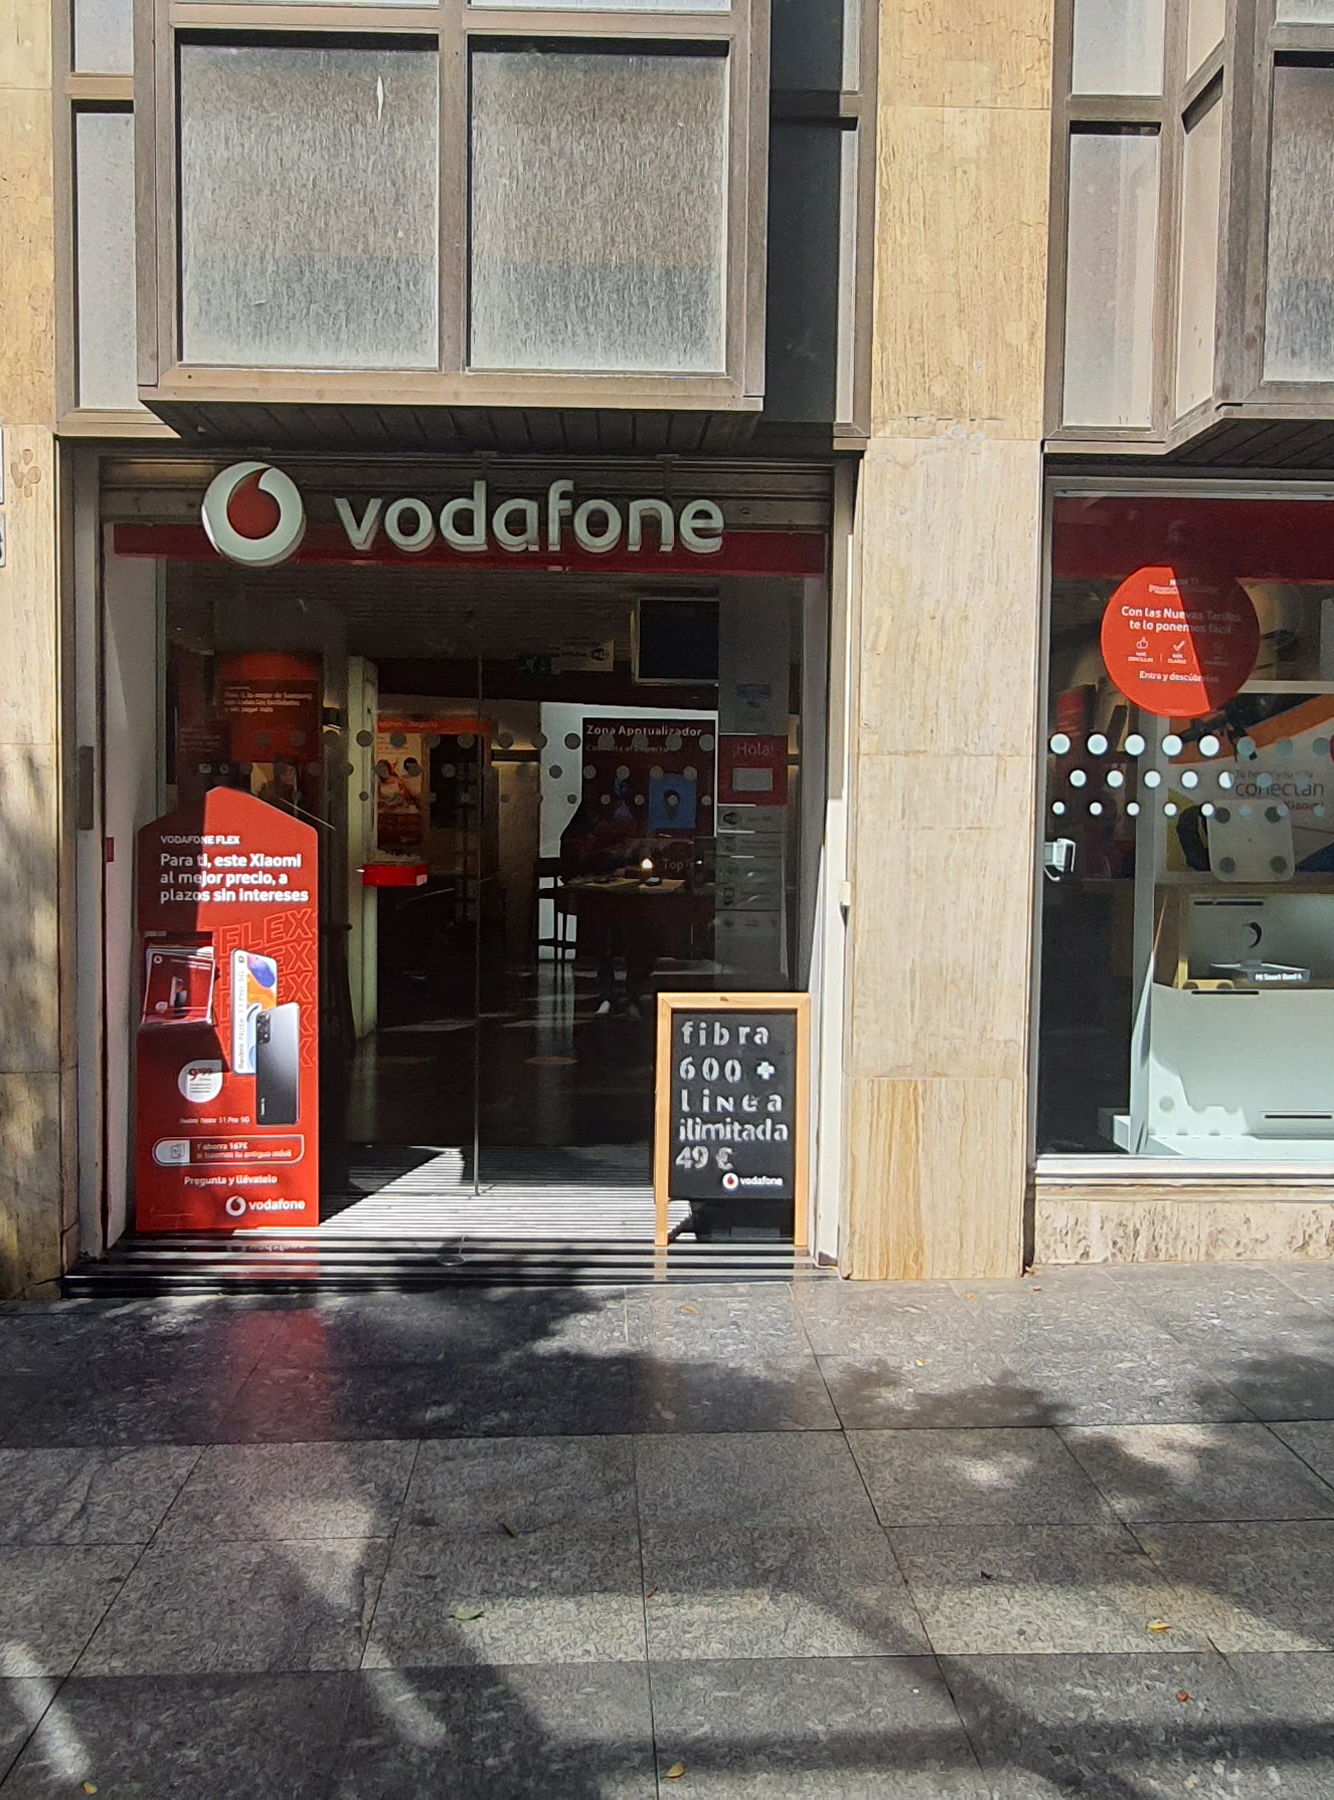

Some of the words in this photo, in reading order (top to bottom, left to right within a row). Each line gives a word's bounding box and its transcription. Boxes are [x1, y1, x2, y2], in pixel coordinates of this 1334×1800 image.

[334, 479, 725, 554] vodafone
[1121, 606, 1143, 616] Con
[1144, 607, 1161, 618] las
[1163, 608, 1204, 620] Nuevas
[1207, 611, 1241, 622] Tarifas
[1129, 620, 1141, 629] te
[1143, 620, 1154, 630] lo
[1156, 622, 1206, 633] ponemos
[1139, 671, 1162, 680] Entra
[1163, 673, 1168, 682] y
[586, 725, 616, 735] Zona
[160, 835, 214, 845] VODAFONE
[216, 835, 240, 845] FLEX
[160, 854, 193, 867] Para
[197, 854, 212, 869] ti,
[214, 854, 247, 867] este
[249, 853, 301, 867] Xiaomi
[160, 871, 174, 884] al
[178, 871, 223, 887] mejor
[225, 871, 276, 887] precio,
[278, 874, 288, 885] a
[160, 889, 211, 904] plazos
[213, 888, 236, 902] sin
[239, 888, 309, 902] intereses
[219, 908, 313, 956] FLEX
[682, 1021, 769, 1046] fibra
[680, 1056, 742, 1083] 600
[757, 1061, 775, 1080] +
[679, 1117, 788, 1141] ilimitada
[675, 1146, 709, 1169] 49
[715, 1147, 734, 1170] €
[184, 1176, 226, 1187] Pregunta
[228, 1177, 235, 1186] y
[236, 1174, 277, 1184] llévatelo
[740, 1176, 783, 1186] vodafone
[249, 1198, 305, 1211] vodafone
